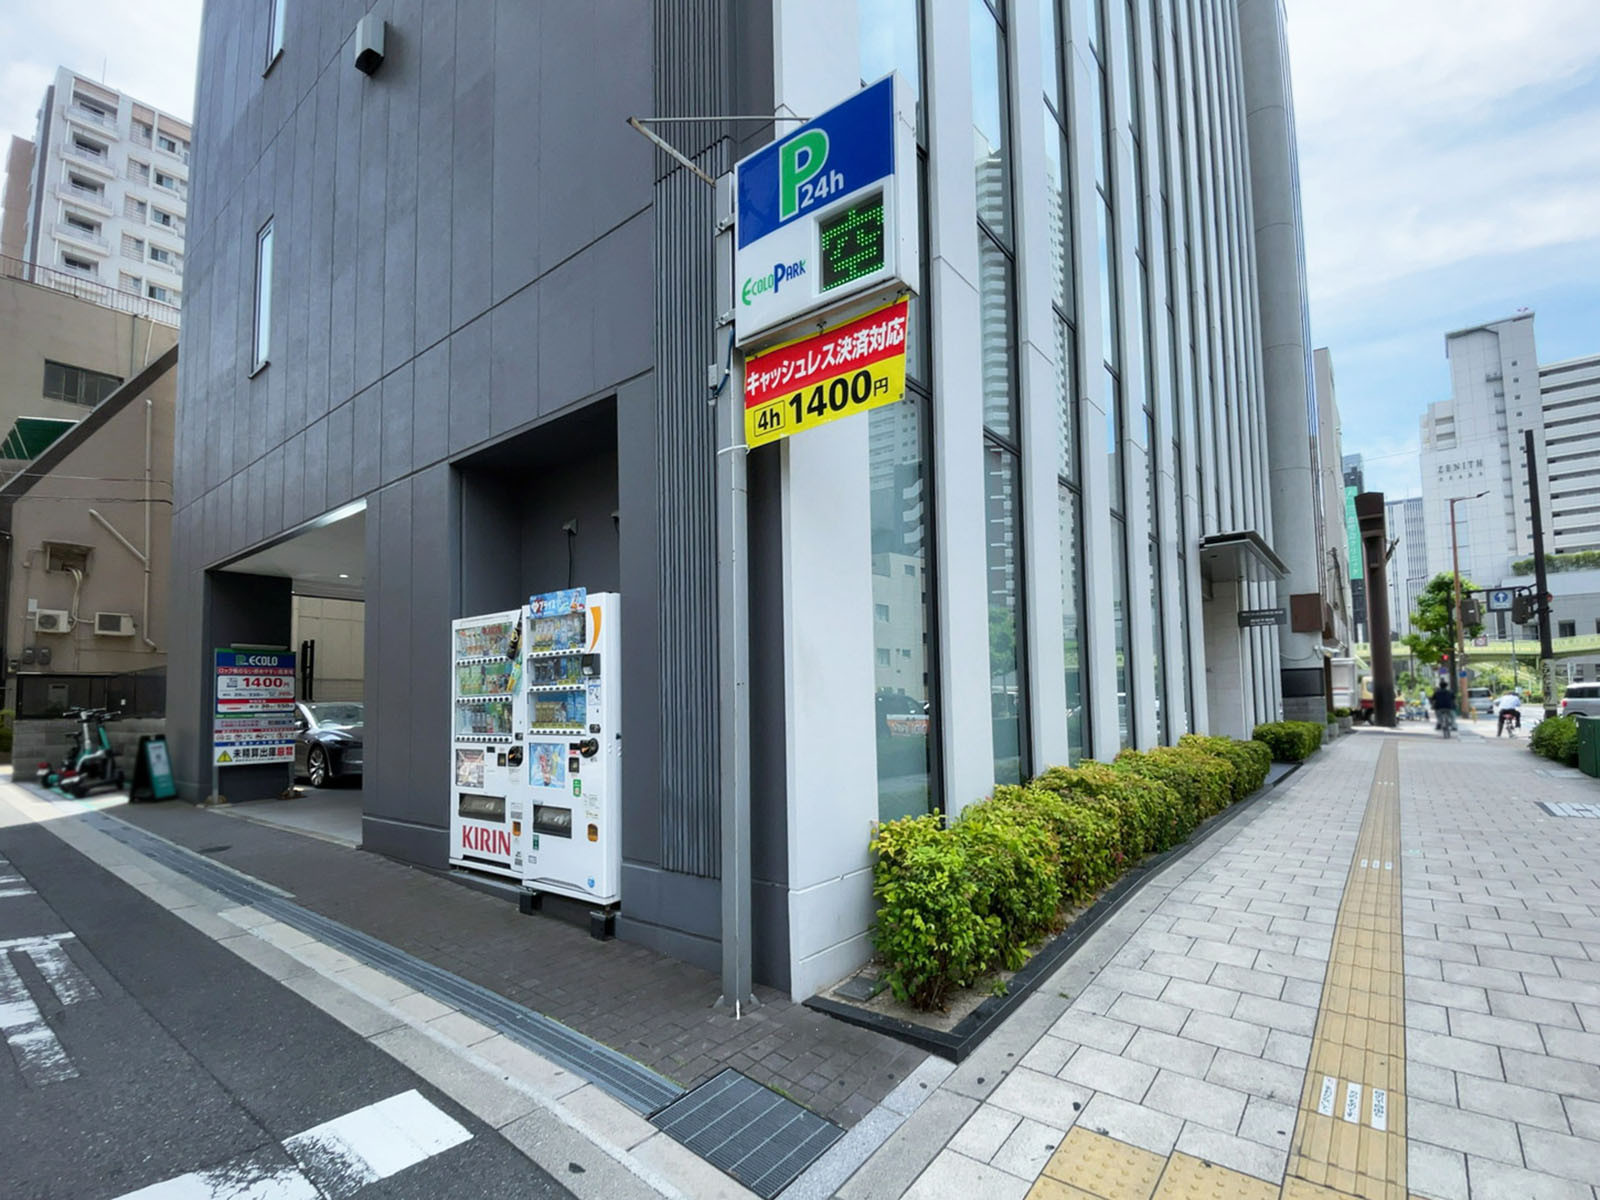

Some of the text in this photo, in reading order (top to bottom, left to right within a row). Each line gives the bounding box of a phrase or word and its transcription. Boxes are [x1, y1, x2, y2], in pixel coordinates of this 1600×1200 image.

[779, 127, 845, 223] P 24h
[822, 205, 885, 291] 空
[746, 316, 906, 397] キャッシュレス決済対応
[757, 369, 889, 431] 4h 1400円
[1438, 458, 1483, 474] ZENITH
[249, 655, 278, 666] ECOLO
[462, 825, 511, 857] KIRIN
